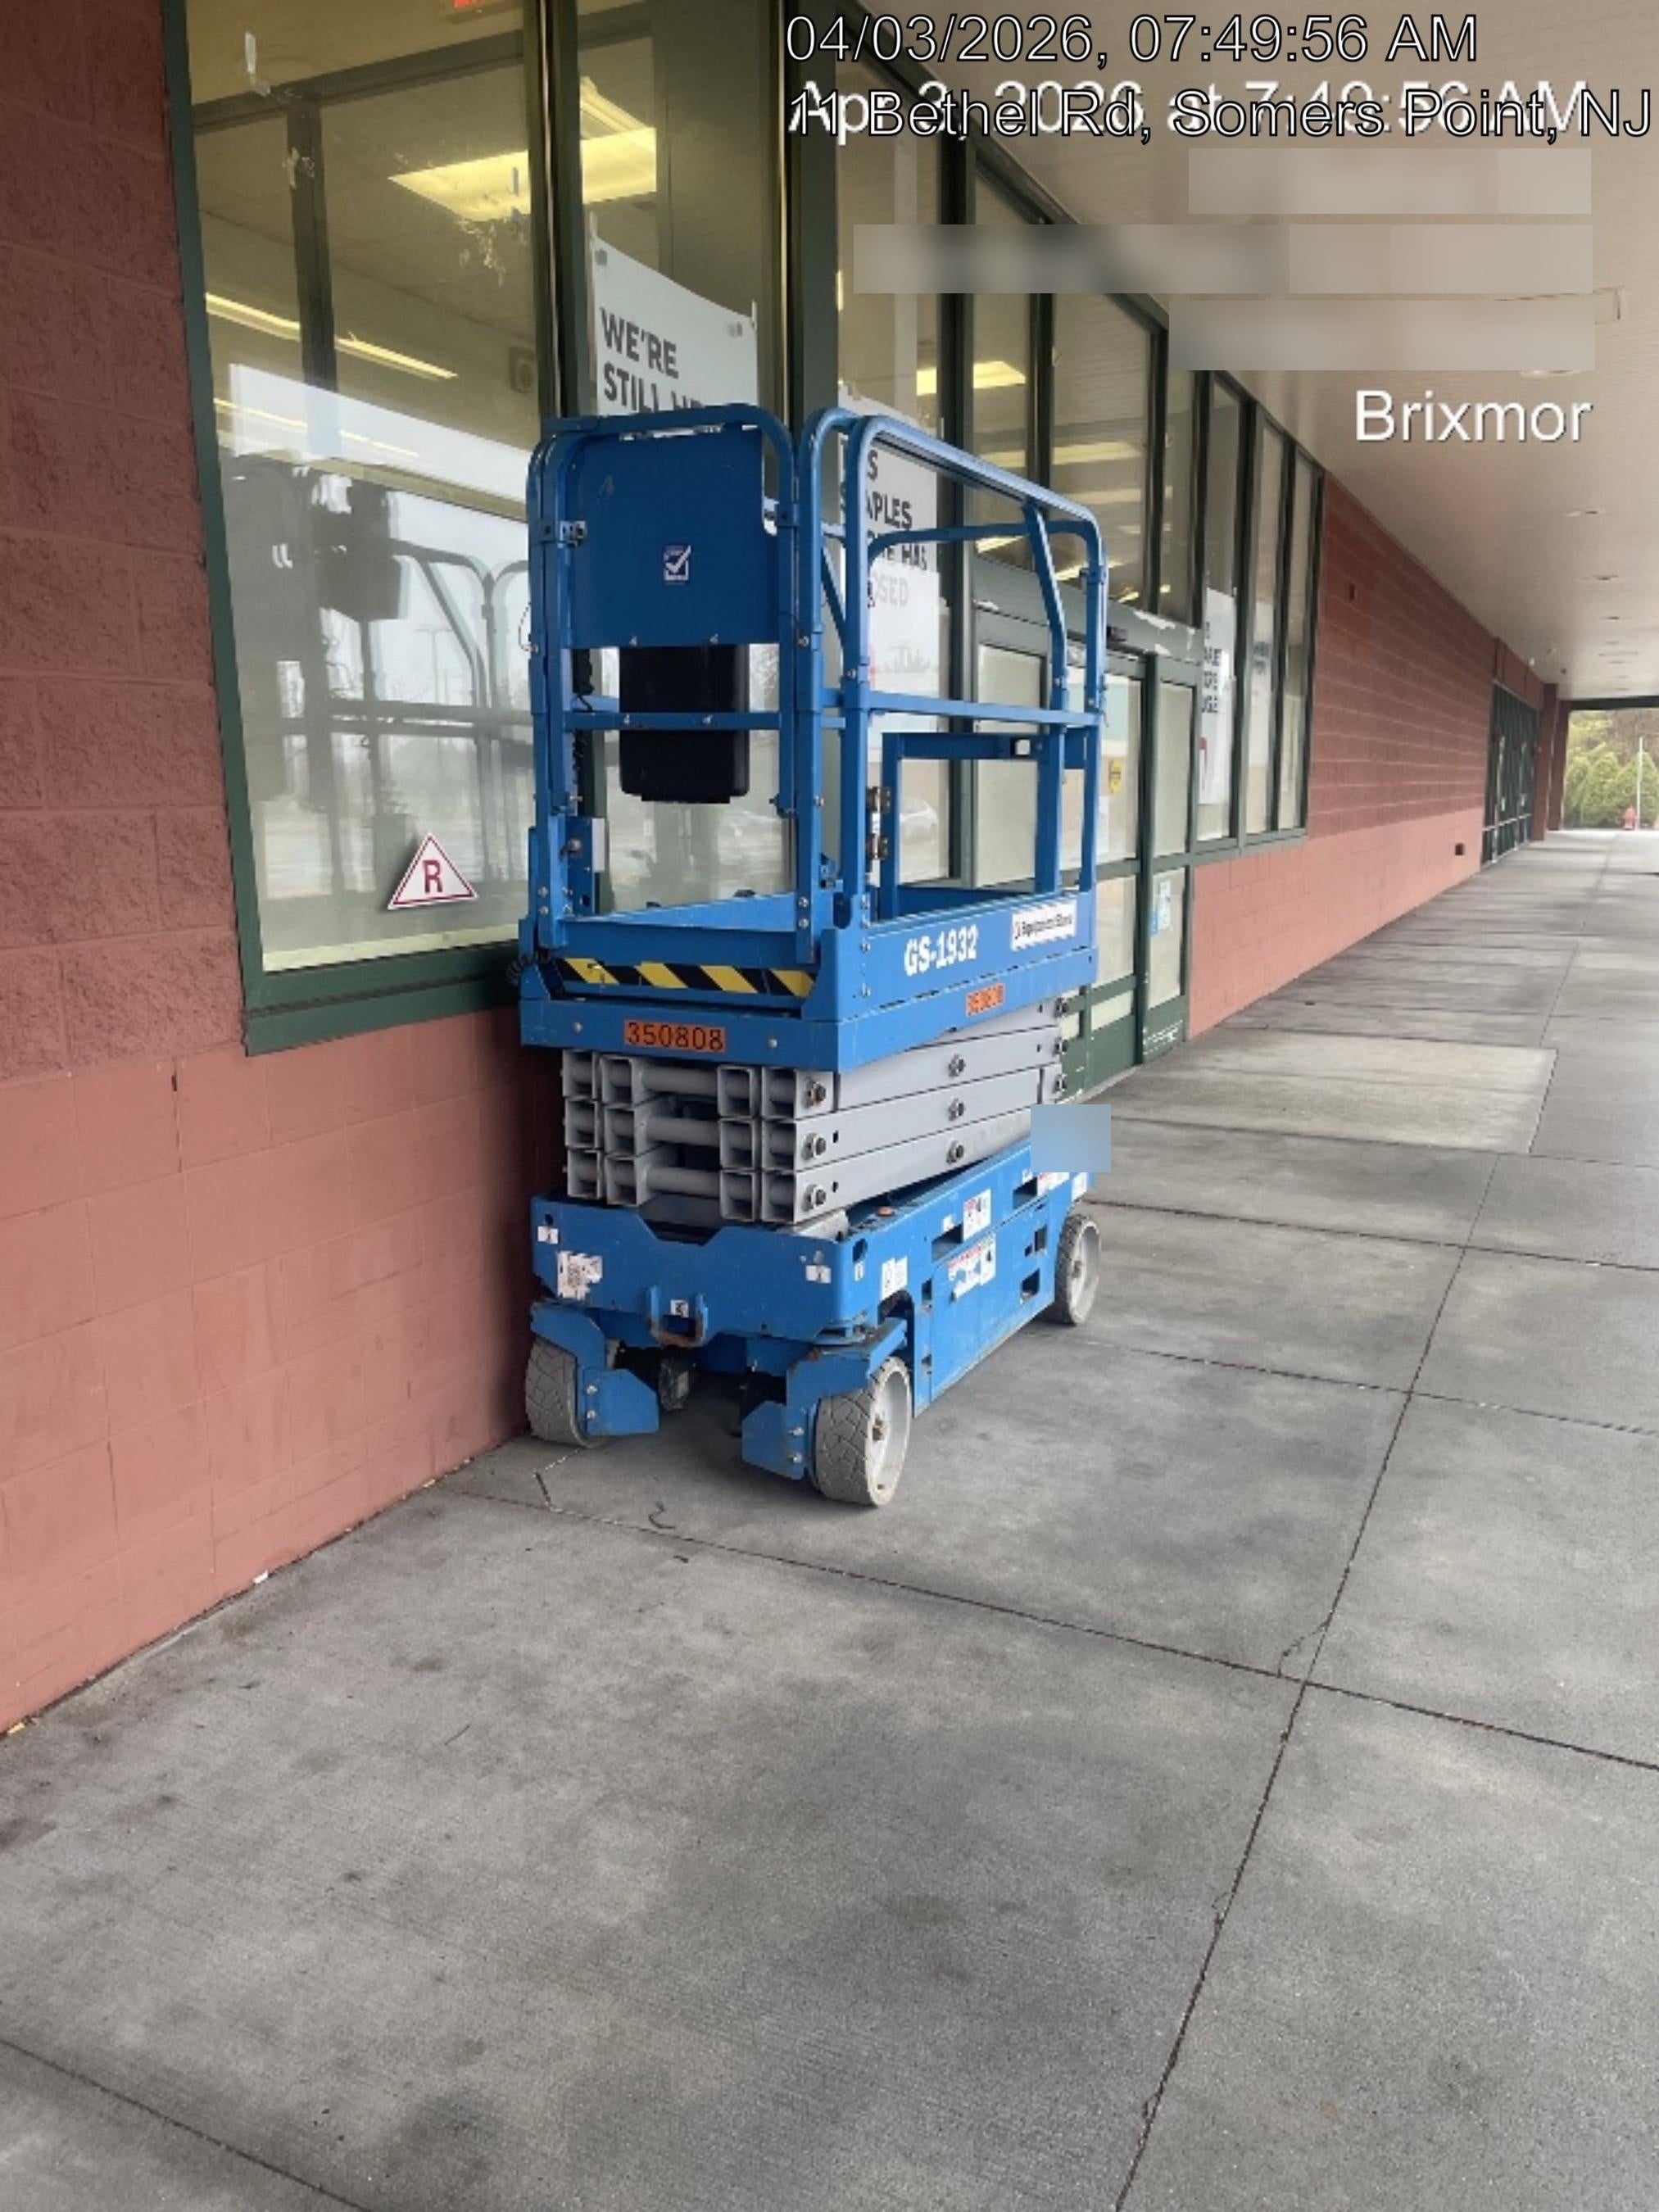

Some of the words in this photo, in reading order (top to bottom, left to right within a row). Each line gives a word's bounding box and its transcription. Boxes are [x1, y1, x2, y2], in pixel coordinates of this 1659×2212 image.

[601, 306, 679, 379] WE'RE
[423, 859, 443, 893] R
[904, 923, 979, 977] GS-1932
[628, 1022, 723, 1051] 350808
